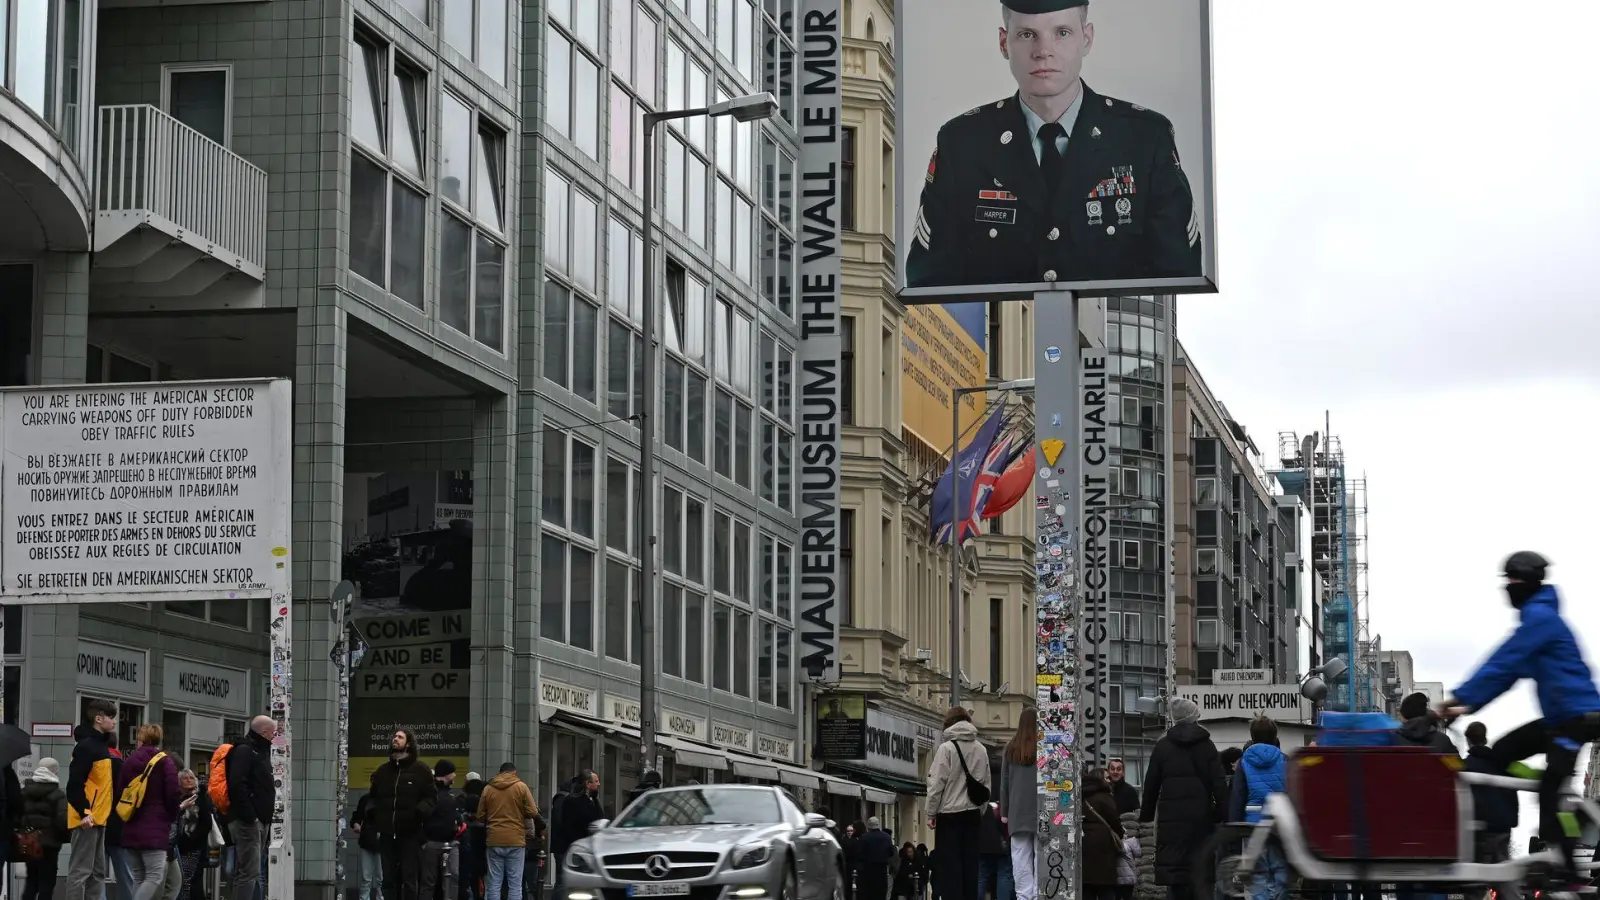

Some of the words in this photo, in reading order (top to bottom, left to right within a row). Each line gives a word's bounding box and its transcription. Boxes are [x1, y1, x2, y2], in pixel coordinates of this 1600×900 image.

[804, 8, 838, 96] MUR
[804, 107, 836, 144] LE
[802, 162, 836, 264] WALL
[984, 210, 1008, 220] HARPER
[802, 274, 835, 340] THE
[23, 395, 44, 410] YOU
[50, 394, 70, 408] ARE
[76, 392, 125, 408] ENTERING
[130, 392, 148, 406] THE
[153, 390, 208, 405] AMERICAN
[214, 388, 254, 402] SECTOR
[22, 410, 76, 426] CARRYING
[80, 409, 132, 424] WEAPONS
[137, 408, 156, 422] OFF
[162, 407, 188, 421] DUTY
[194, 405, 253, 420] FORBIDDEN
[1084, 357, 1106, 466] CHARLIE
[82, 427, 108, 441] OBEY
[115, 426, 156, 440] TRAFFIC
[162, 424, 195, 438] RULES
[28, 454, 44, 468] ВЫ
[48, 453, 102, 468] ВЕЗЖАЕТЕ
[108, 452, 114, 466] В
[120, 448, 204, 466] АМЕРИКАНСКИЙ
[210, 448, 248, 462] СЕКТОР
[18, 470, 50, 486] НОСИТЬ
[54, 470, 90, 484] ОРУЖИЕ
[93, 468, 144, 484] ЗАПРЕЩЕНО
[148, 466, 154, 481] В
[158, 466, 222, 481] НЕСЛУЖЕБНОЕ
[226, 464, 256, 479] ВРЕМЯ
[110, 486, 172, 500] ДОРОЖНЫМ
[180, 484, 238, 498] ПРАВИЛАМ
[18, 514, 45, 528] VOUS
[52, 512, 88, 526] ENTREZ
[95, 512, 122, 526] DANS
[128, 512, 137, 524] LE
[144, 510, 189, 525] SECTEUR
[801, 360, 836, 669] MAUERMUSEUM
[17, 530, 53, 544] DEFENSE
[102, 528, 118, 542] DES
[120, 527, 149, 540] ARMES
[152, 526, 164, 540] EN
[166, 526, 201, 539] DEHORS
[204, 524, 217, 538] DU
[220, 524, 256, 538] SERVICE
[30, 546, 80, 560] OBEISSEZ
[86, 545, 107, 558] AUX
[113, 544, 150, 558] REGLES
[156, 543, 168, 556] DE
[174, 542, 242, 556] CIRCULATION
[1084, 474, 1107, 645] CHECKPOINT
[17, 574, 32, 589] SIE
[38, 572, 87, 588] BETRETEN
[92, 571, 112, 586] DEN
[117, 569, 208, 586] AMERIKANISCHEN
[213, 568, 254, 584] SEKTOR
[366, 618, 431, 640] COME
[442, 614, 462, 634] IN
[370, 650, 410, 667] AND
[420, 648, 444, 664] BE
[106, 658, 137, 682] CHARLIE
[1085, 654, 1106, 698] AM
[1220, 672, 1236, 681] ALLIED
[1236, 672, 1264, 681] CHECKPOINT
[179, 672, 230, 698] MUSEUMSSHOP
[364, 673, 420, 692] PART
[431, 672, 458, 690] OF
[542, 683, 570, 706] CHECKPOINT
[571, 690, 590, 712] CHARLIE
[1204, 694, 1234, 710] ARMY
[614, 702, 625, 718] WALL
[448, 722, 466, 730] allen
[714, 726, 733, 746] CHECKPOINT
[734, 731, 748, 748] CHARLIE
[440, 741, 459, 749] since
[759, 736, 776, 756] CHECKPOINT
[777, 740, 789, 758] CHARLIE
[892, 732, 914, 764] CHARLIE
[1084, 706, 1106, 775] AUS
